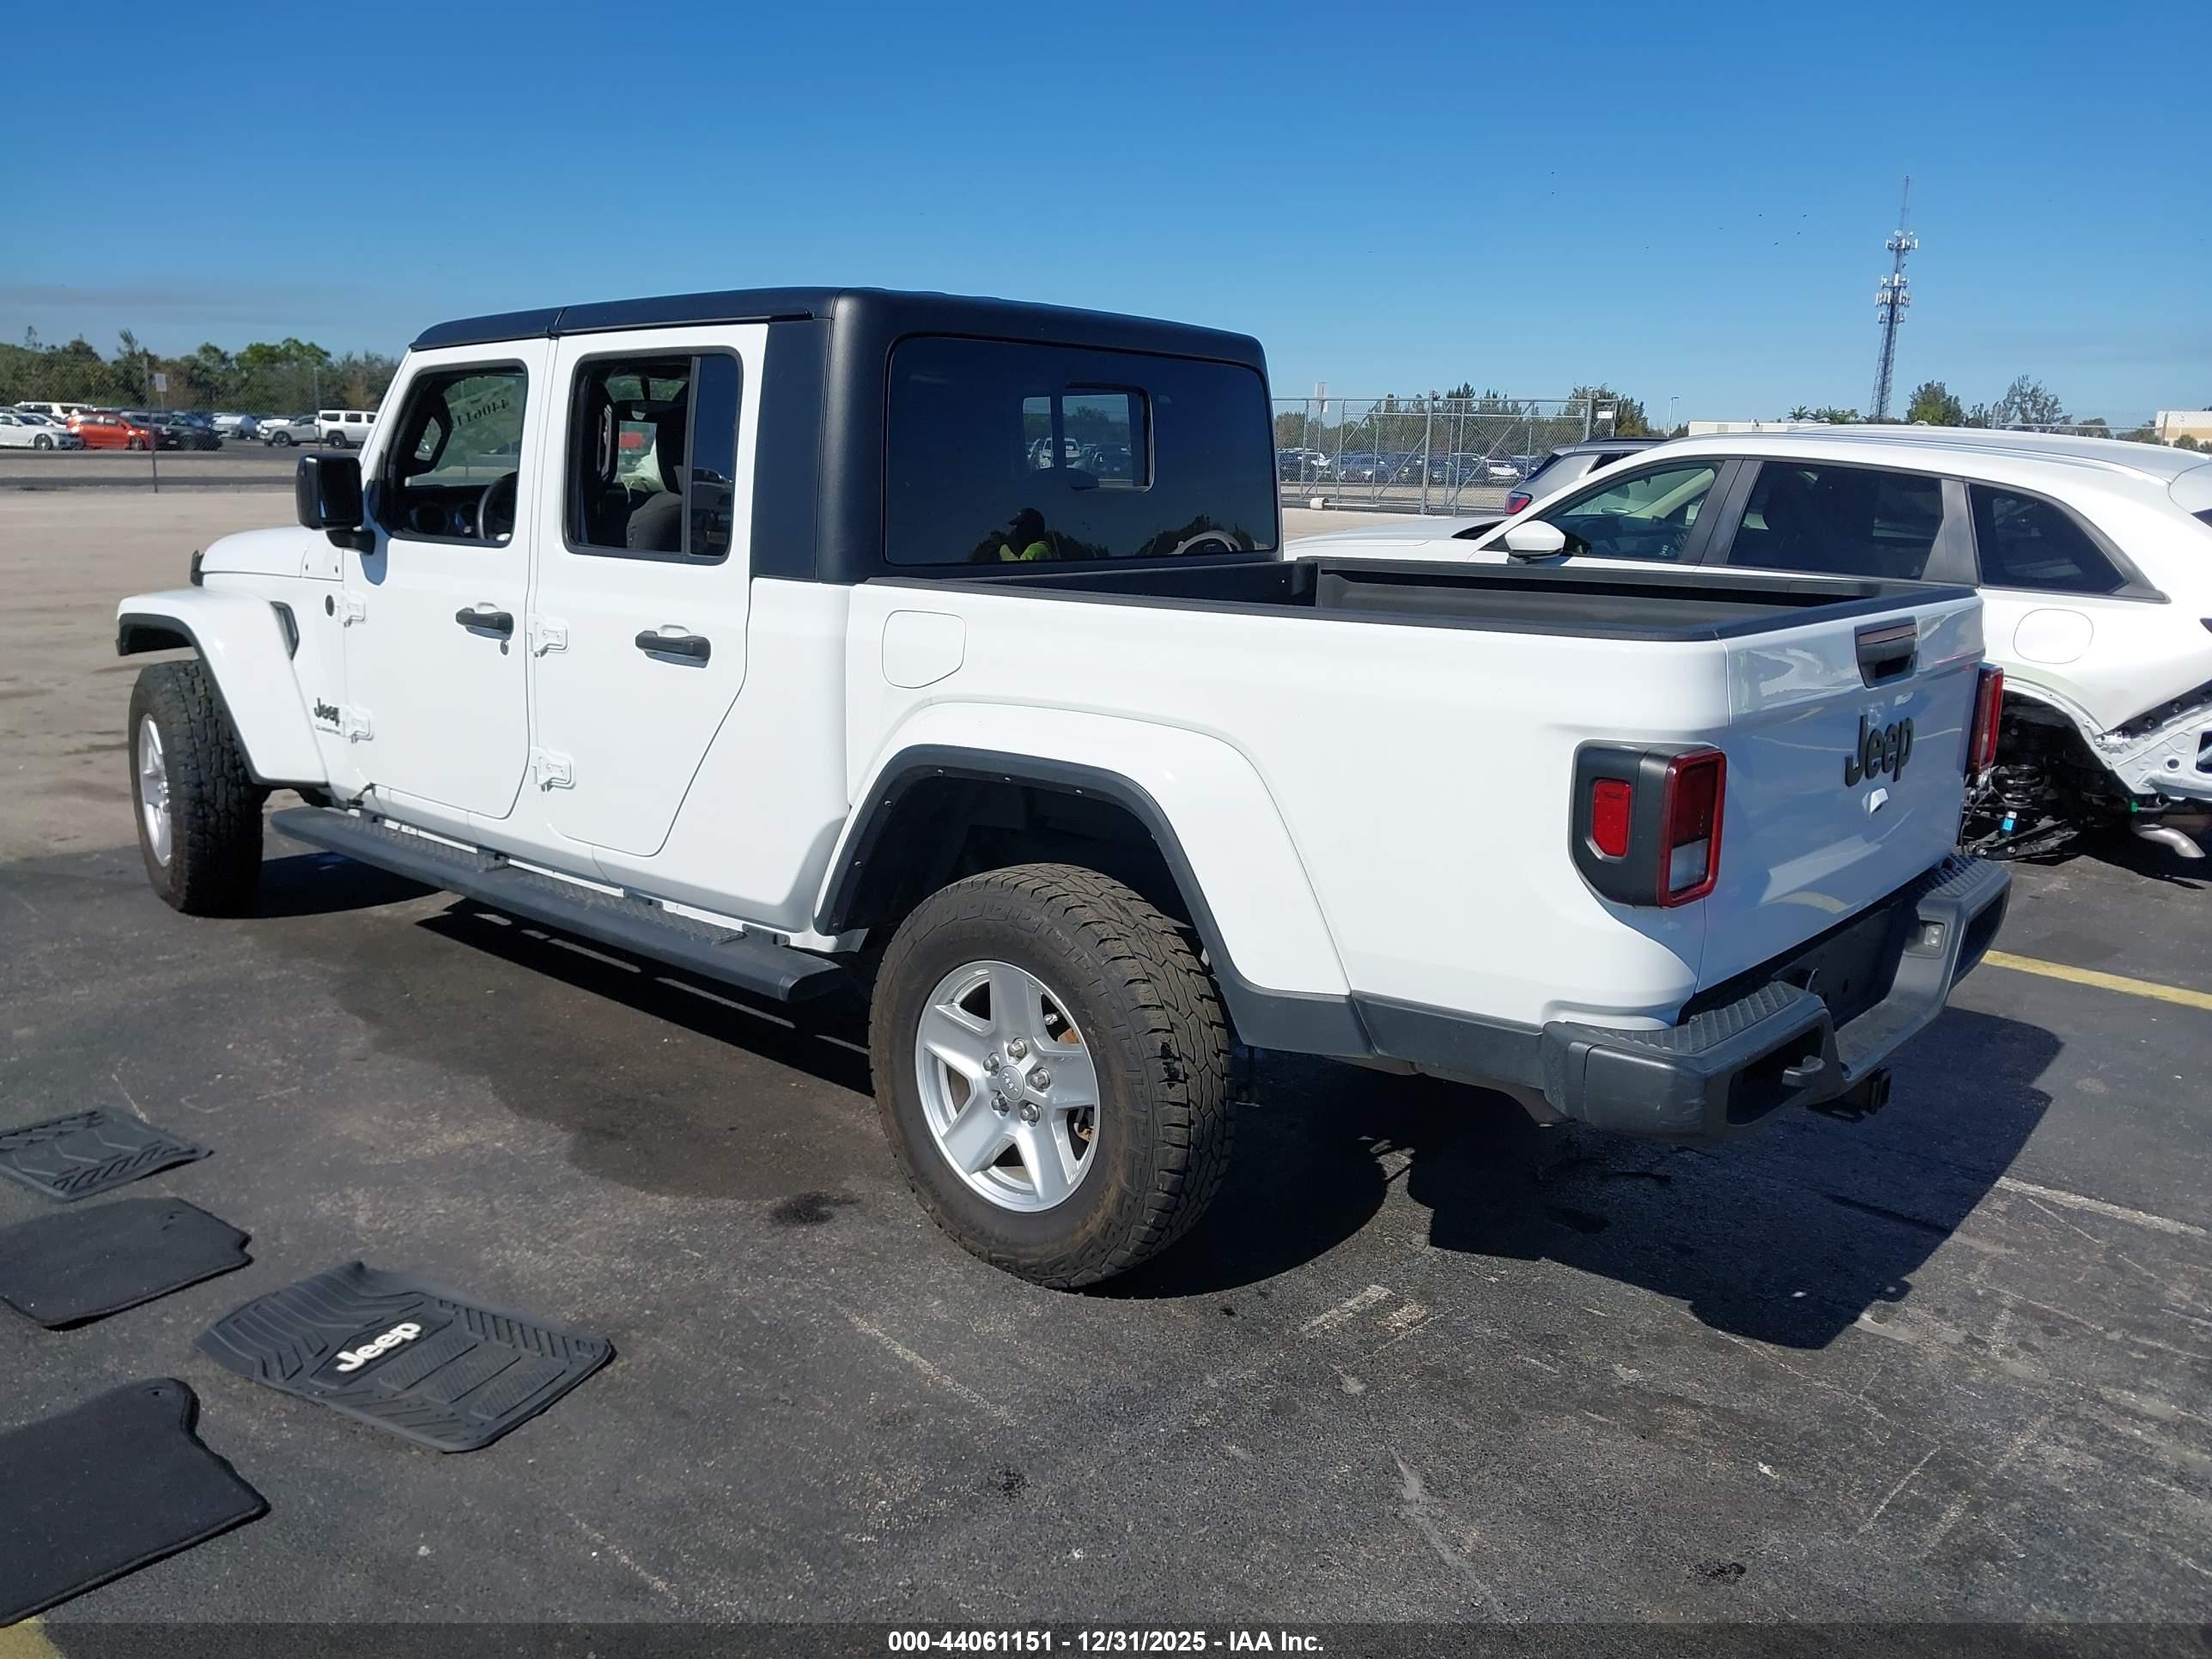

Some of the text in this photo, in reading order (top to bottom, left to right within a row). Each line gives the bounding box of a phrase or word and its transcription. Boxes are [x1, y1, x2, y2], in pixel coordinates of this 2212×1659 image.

[313, 696, 340, 728] Jeep
[1844, 714, 1914, 787] Jeep
[336, 1322, 422, 1372] Jeep
